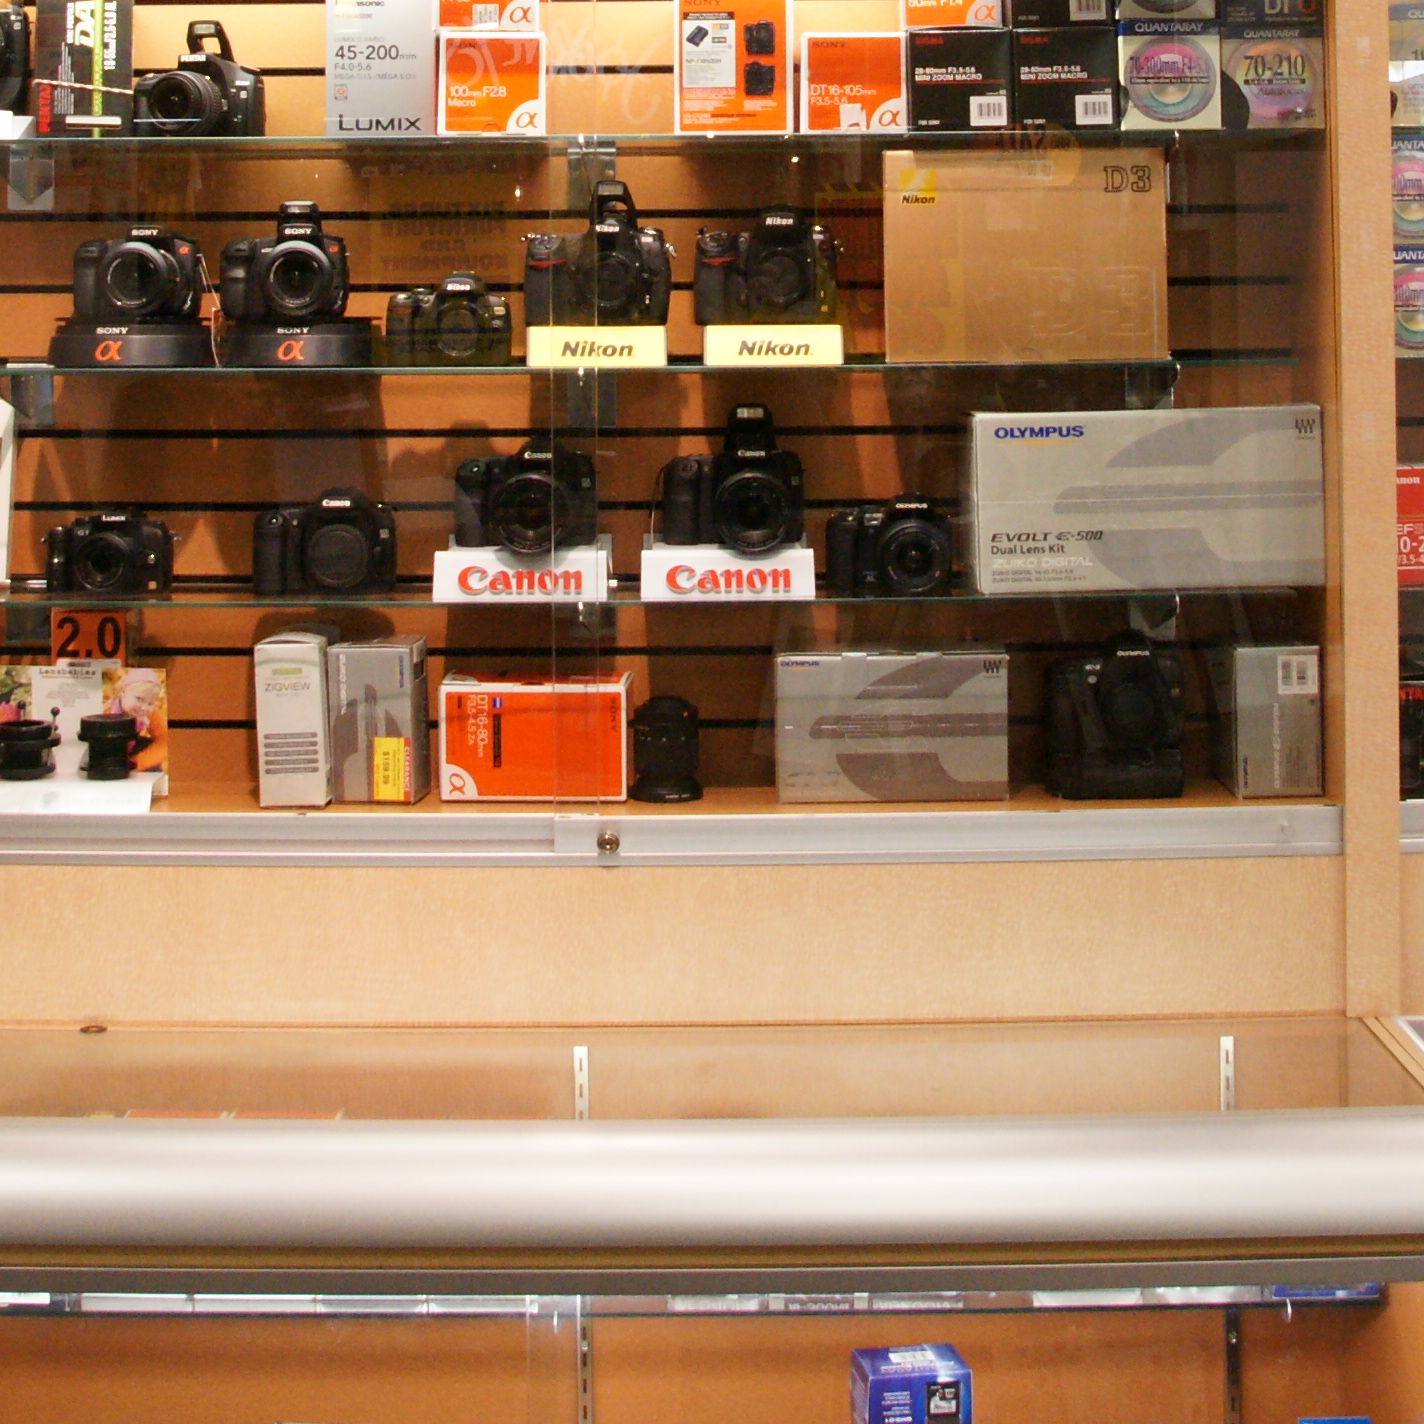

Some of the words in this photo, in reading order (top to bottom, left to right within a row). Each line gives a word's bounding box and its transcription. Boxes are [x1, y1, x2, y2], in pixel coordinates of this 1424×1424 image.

[1243, 54, 1306, 77] 70-210
[338, 114, 422, 131] LUMIX
[1104, 166, 1152, 193] D3
[901, 194, 936, 205] Nikon
[561, 341, 634, 358] Nikon
[738, 339, 811, 356] Nikon
[994, 425, 1085, 440] OLYMPUS
[990, 532, 1050, 543] EVOLT
[991, 544, 1018, 555] Dual
[1020, 543, 1046, 554] Lens
[1049, 543, 1065, 554] Kit
[457, 566, 582, 595] Canon
[666, 564, 791, 594] Canon
[57, 617, 122, 658] 2.0
[265, 682, 311, 692] ZIGVIEW
